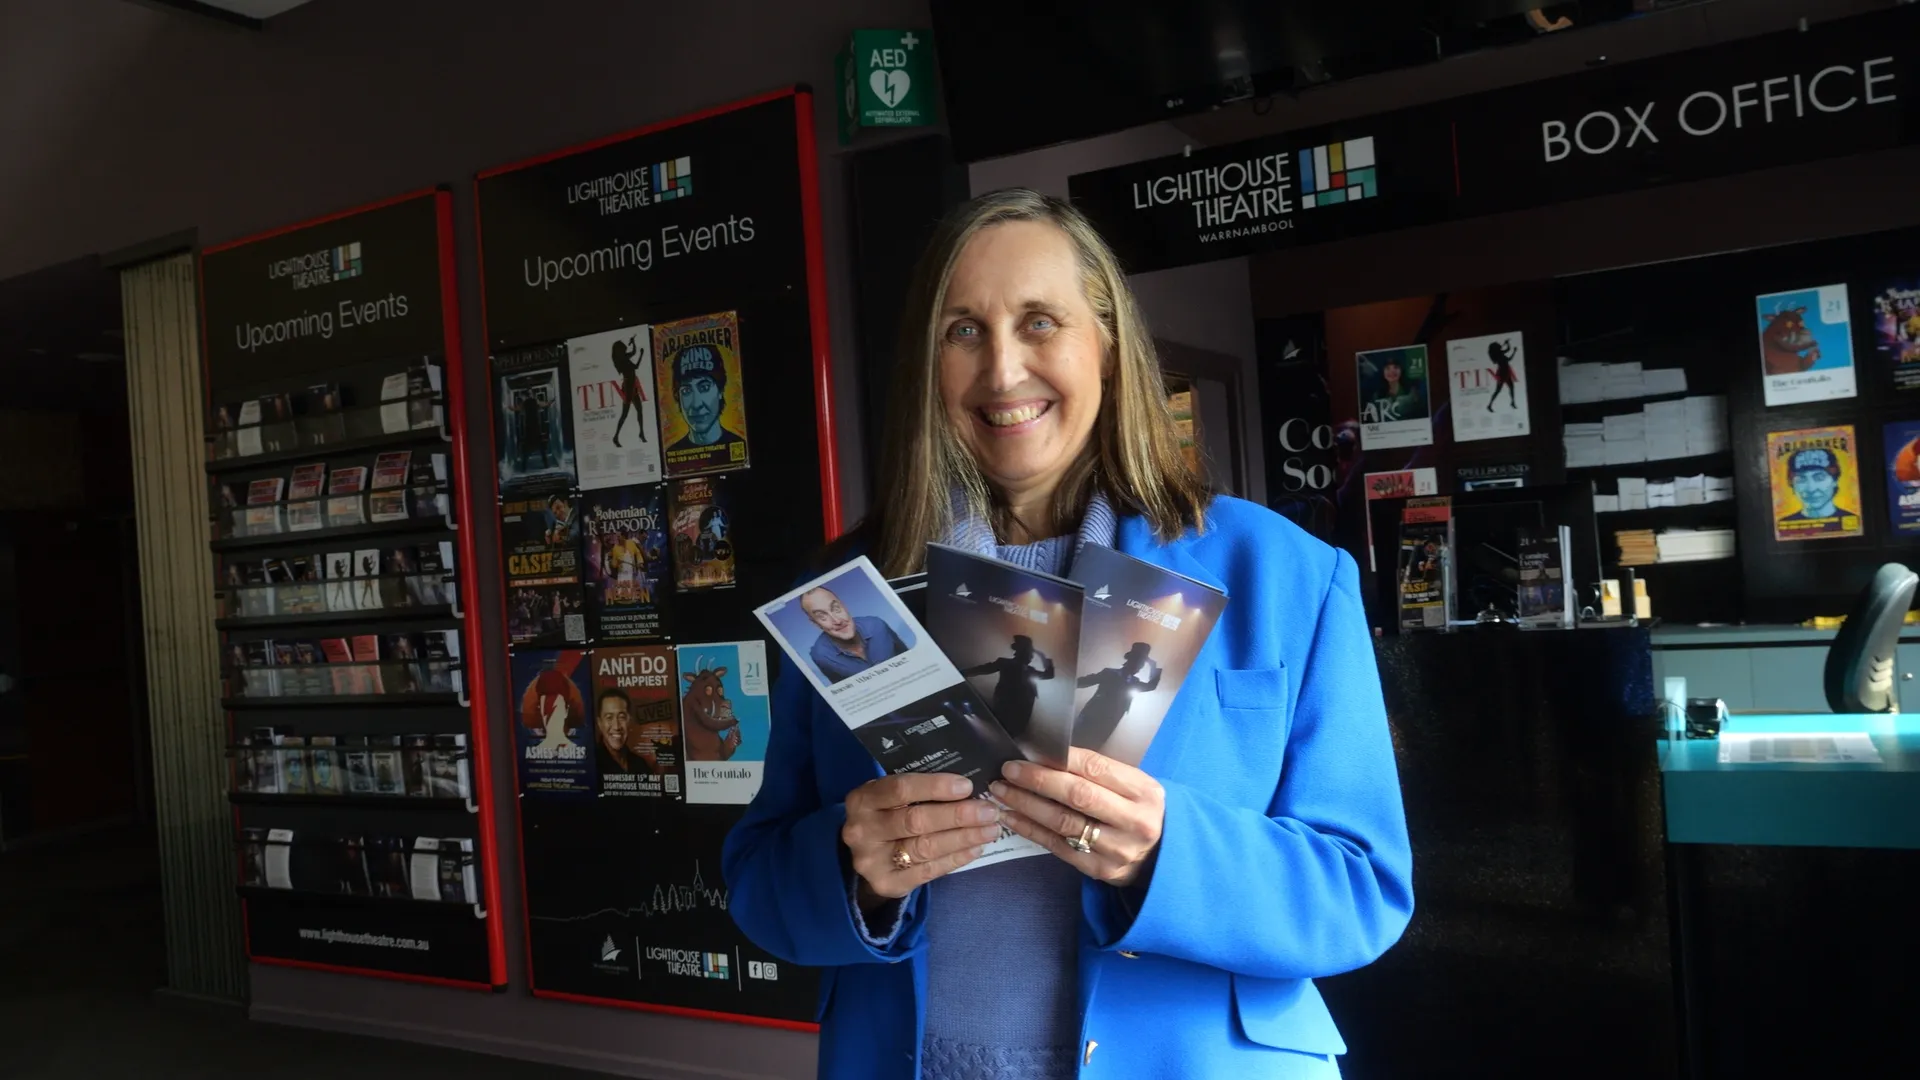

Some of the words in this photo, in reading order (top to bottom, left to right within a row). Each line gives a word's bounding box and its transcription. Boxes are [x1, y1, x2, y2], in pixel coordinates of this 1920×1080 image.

[870, 48, 907, 68] AED
[1542, 101, 1659, 163] BOX
[1676, 56, 1898, 137] OFFICE
[567, 165, 649, 204] LIGHTHOUSE
[1133, 152, 1291, 210] LIGHTHOUSE
[598, 187, 651, 217] THEATRE
[1191, 184, 1293, 229] THEATRE
[1199, 219, 1294, 244] WARRNAMBOOL
[523, 236, 653, 290] Upcoming
[662, 214, 756, 259] Events
[268, 249, 330, 280] LIGHTHOUSE
[292, 267, 331, 290] THEATRE
[236, 310, 334, 353] Upcoming
[338, 292, 409, 329] Events
[683, 327, 733, 352] BARKER
[680, 346, 713, 366] MIND
[681, 361, 714, 375] FIELD
[1453, 362, 1521, 390] TINA
[577, 375, 649, 412] TINA
[1360, 398, 1402, 424] ARC
[1278, 417, 1335, 453] Co
[1282, 456, 1337, 492] So
[677, 489, 713, 502] MUSICALS
[593, 504, 647, 521] Bohemian
[588, 514, 659, 537] RHAPSODY
[508, 552, 553, 576] CASH
[598, 657, 635, 676] ANH
[640, 655, 667, 675] DO
[744, 662, 761, 678] 21
[617, 674, 668, 688] HAPPIEST
[525, 745, 553, 759] ASHES
[603, 773, 635, 782] WEDNESDAY
[648, 774, 661, 782] MAY
[693, 768, 710, 779] The
[603, 782, 637, 790] LIGHTHOUSE
[638, 782, 661, 791] THEATRE
[298, 927, 430, 951] www.lighthousetheatre.com.au
[646, 946, 701, 964] LIGHTHOUSE
[666, 961, 702, 977] THEATRE
